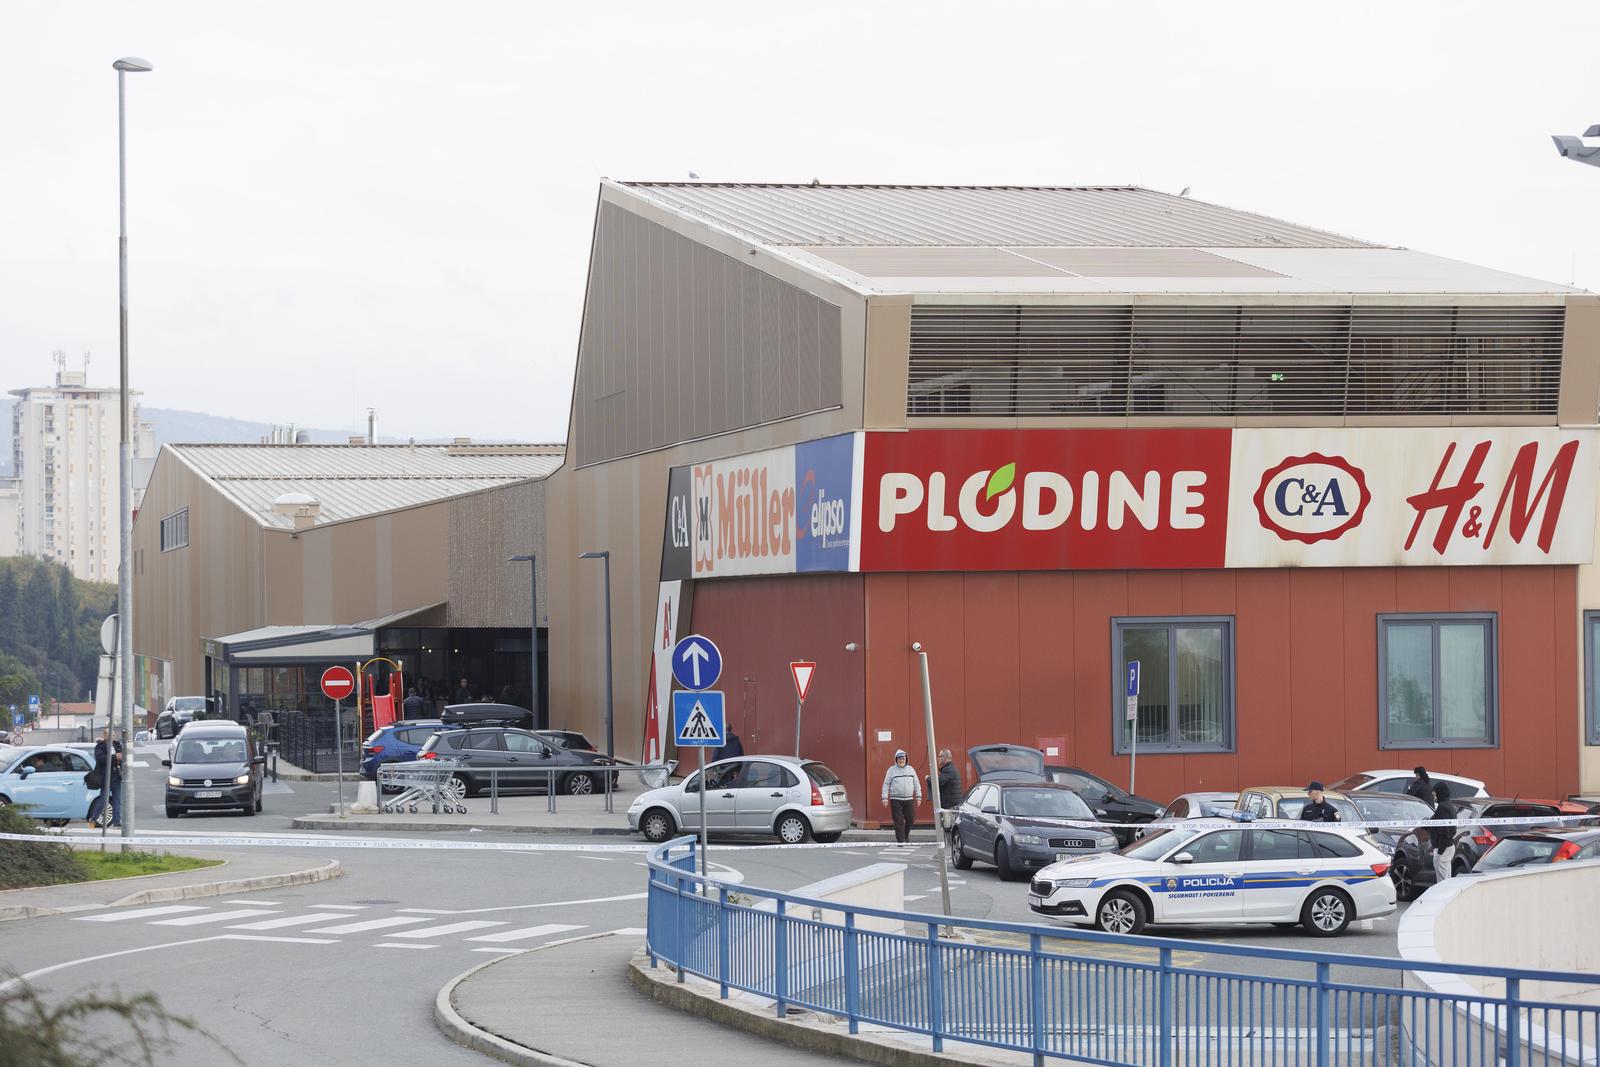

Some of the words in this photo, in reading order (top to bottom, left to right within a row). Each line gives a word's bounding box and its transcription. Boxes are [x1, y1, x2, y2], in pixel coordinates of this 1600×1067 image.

[699, 496, 709, 542] M
[716, 466, 794, 560] Müller
[811, 489, 844, 548] elipso
[878, 469, 1208, 533] PLODINE
[1274, 477, 1350, 518] C&A
[1404, 439, 1580, 555] H&M
[1182, 878, 1234, 887] POLICIJA
